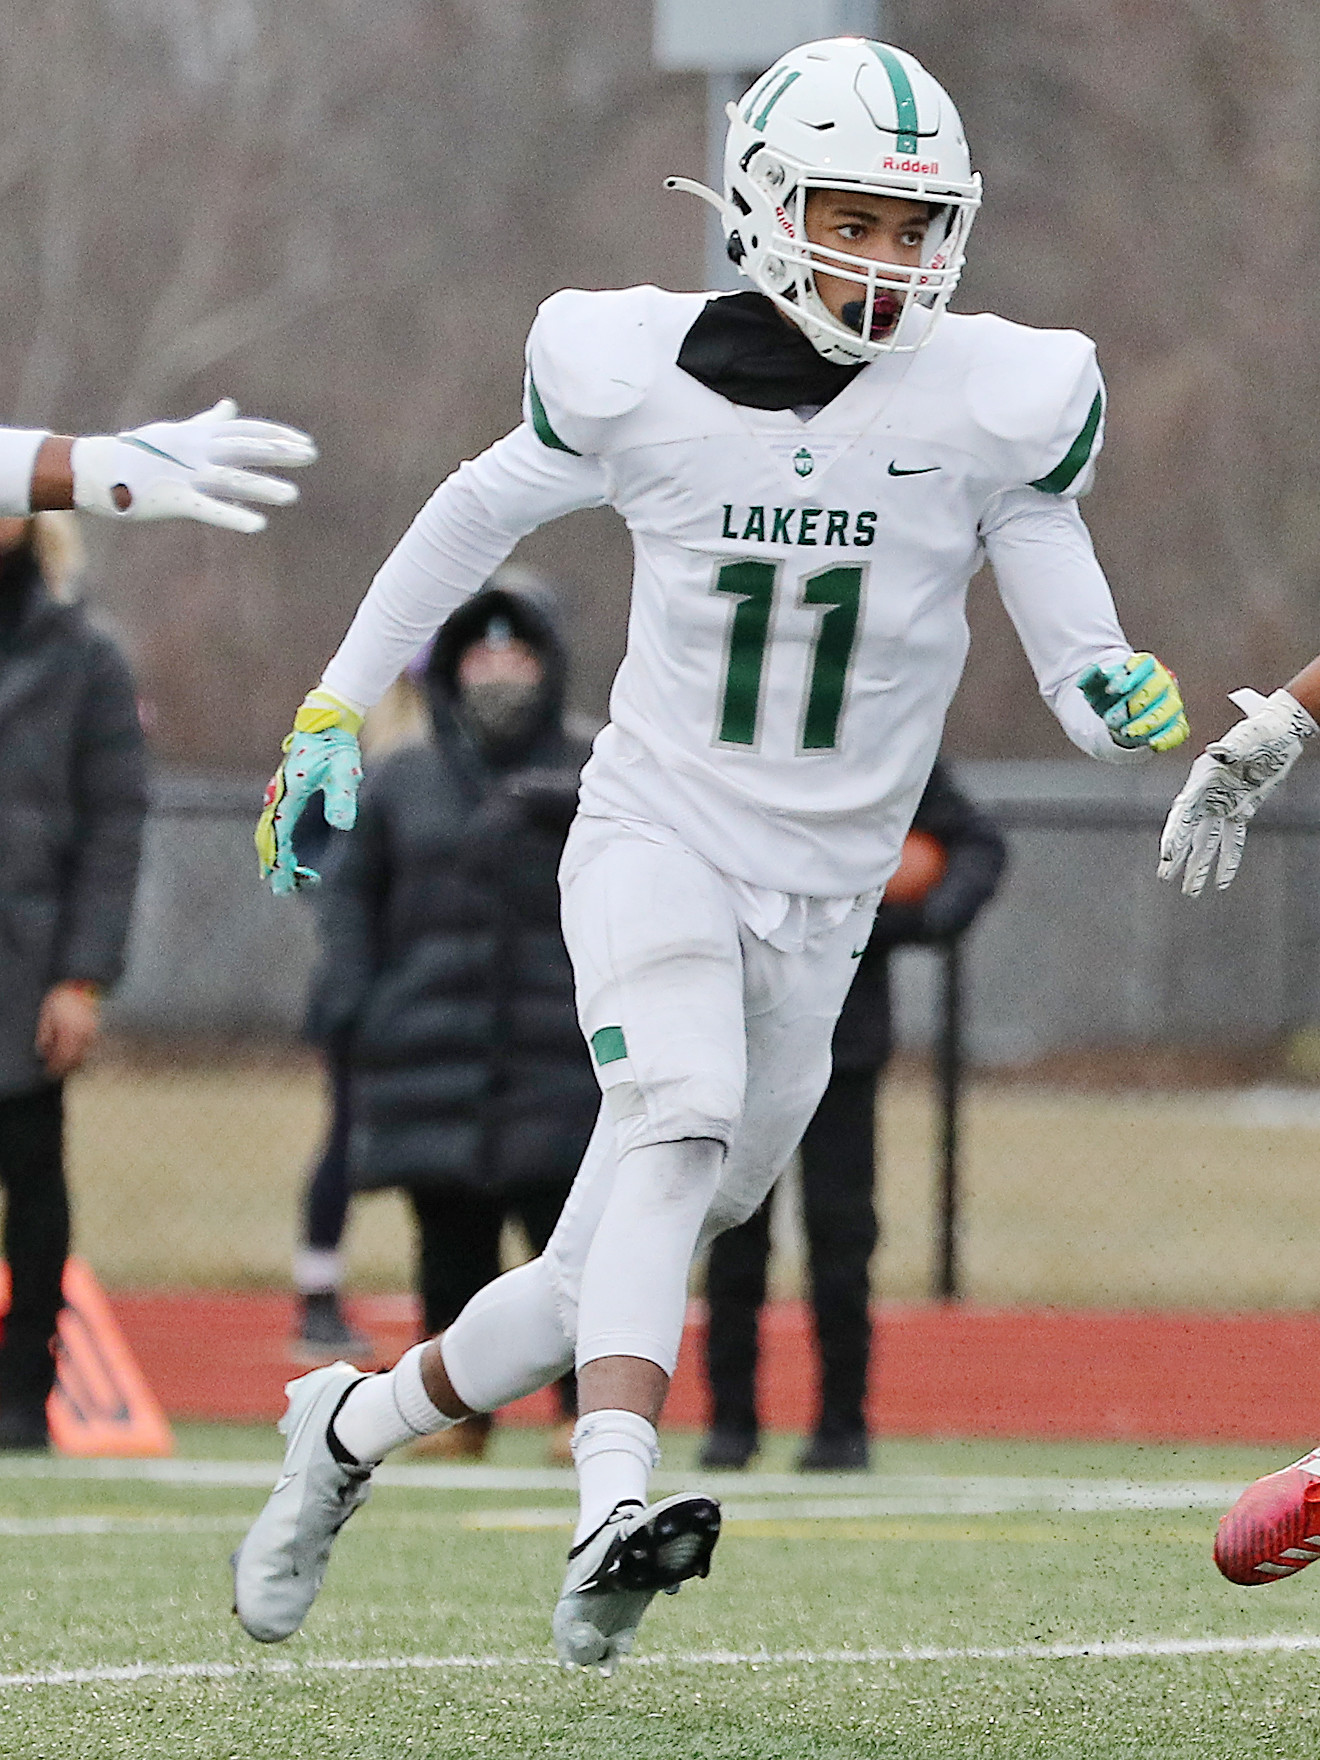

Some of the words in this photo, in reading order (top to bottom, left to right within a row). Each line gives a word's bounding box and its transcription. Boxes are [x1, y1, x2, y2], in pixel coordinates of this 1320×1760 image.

[883, 157, 939, 174] Riddell
[722, 504, 878, 546] LAKERS
[708, 555, 871, 757] 11
